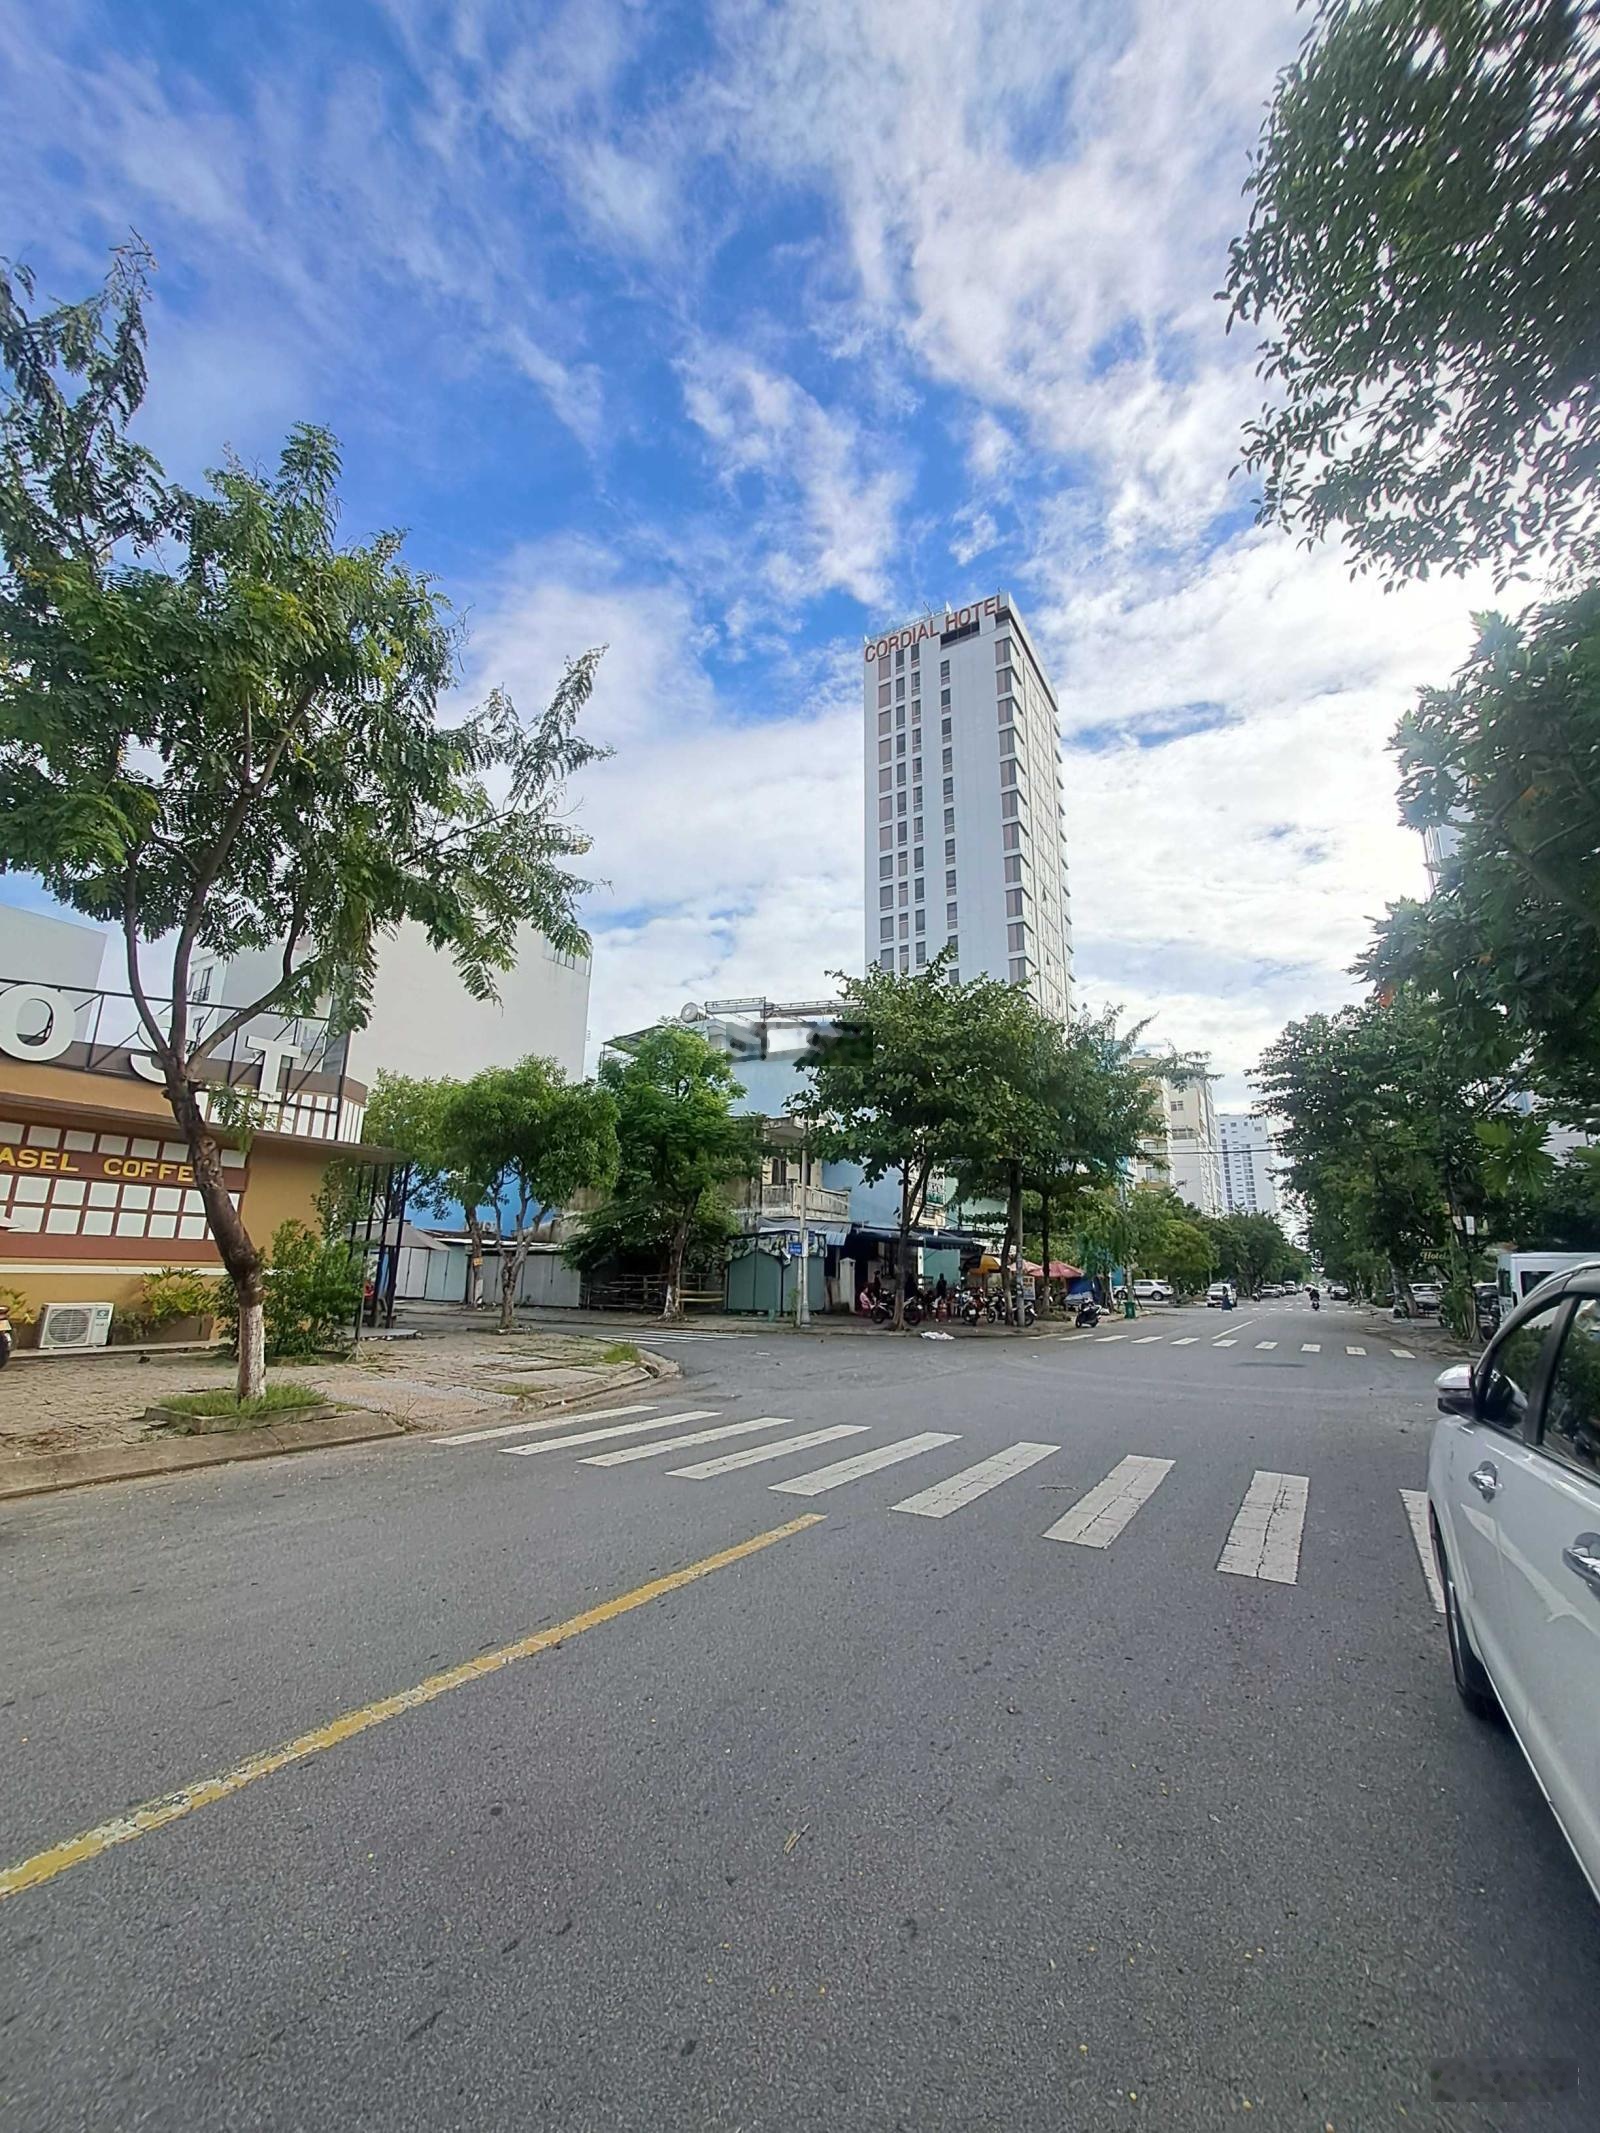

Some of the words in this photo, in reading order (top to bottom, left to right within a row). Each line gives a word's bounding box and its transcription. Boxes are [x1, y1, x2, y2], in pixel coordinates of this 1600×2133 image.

[865, 620, 940, 663] CORDIAL
[945, 595, 1008, 632] HOTEL
[103, 1158, 194, 1182] COFFE
